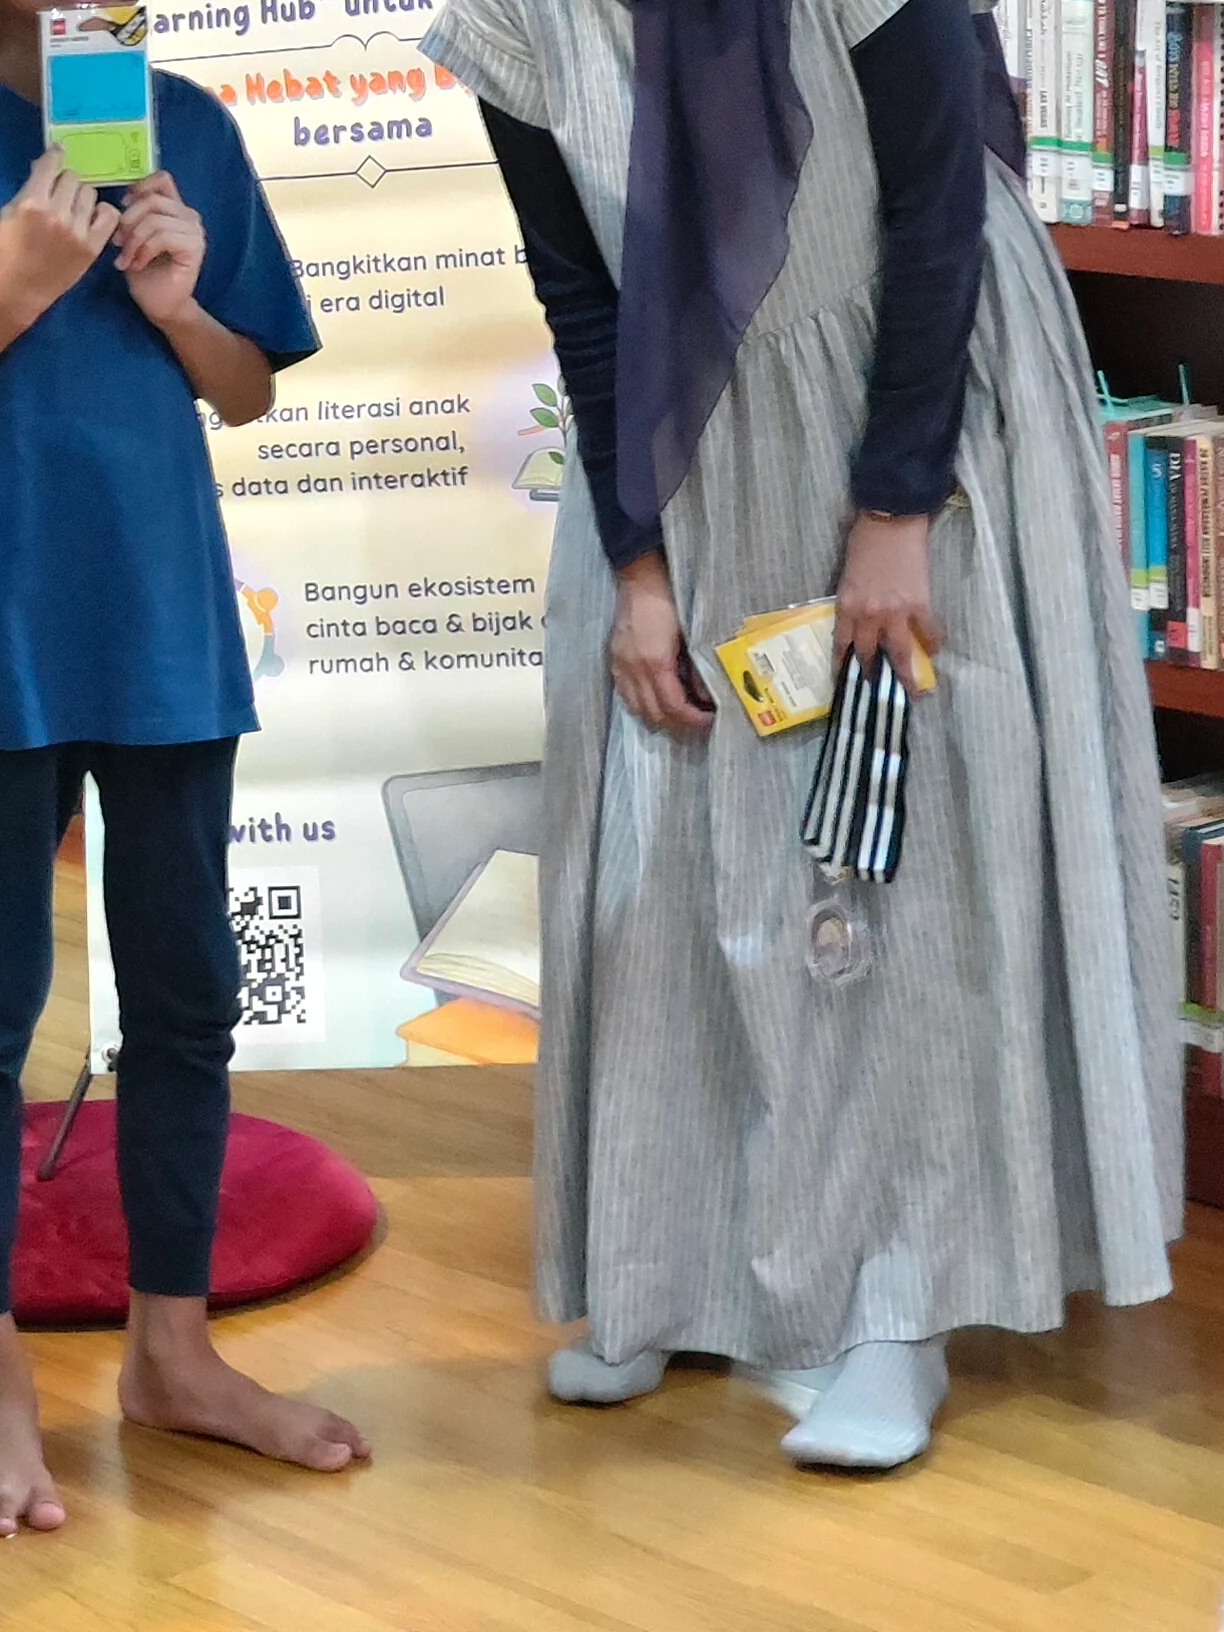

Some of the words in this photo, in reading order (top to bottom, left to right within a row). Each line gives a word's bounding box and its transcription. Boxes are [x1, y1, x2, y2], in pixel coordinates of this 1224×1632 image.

[244, 68, 341, 105] Hebat
[349, 67, 427, 106] yang
[293, 115, 434, 147] bersama
[290, 251, 428, 280] Bangkitkan
[434, 247, 507, 269] minat
[320, 294, 361, 314] era
[368, 286, 445, 314] digital
[317, 397, 401, 421] literasi
[408, 393, 471, 417] anak
[257, 440, 341, 460] secara
[349, 430, 466, 461] personal,
[232, 476, 288, 497] data
[297, 473, 344, 494] dan
[350, 466, 469, 490] interaktif
[304, 581, 399, 605] Bangun
[408, 575, 536, 598] ekosistem
[306, 618, 368, 639] cinta
[375, 615, 438, 636] baca
[445, 613, 465, 633] &
[471, 610, 534, 637] bijak
[308, 654, 390, 675] rumah
[397, 651, 416, 672] &
[302, 818, 337, 842] us
